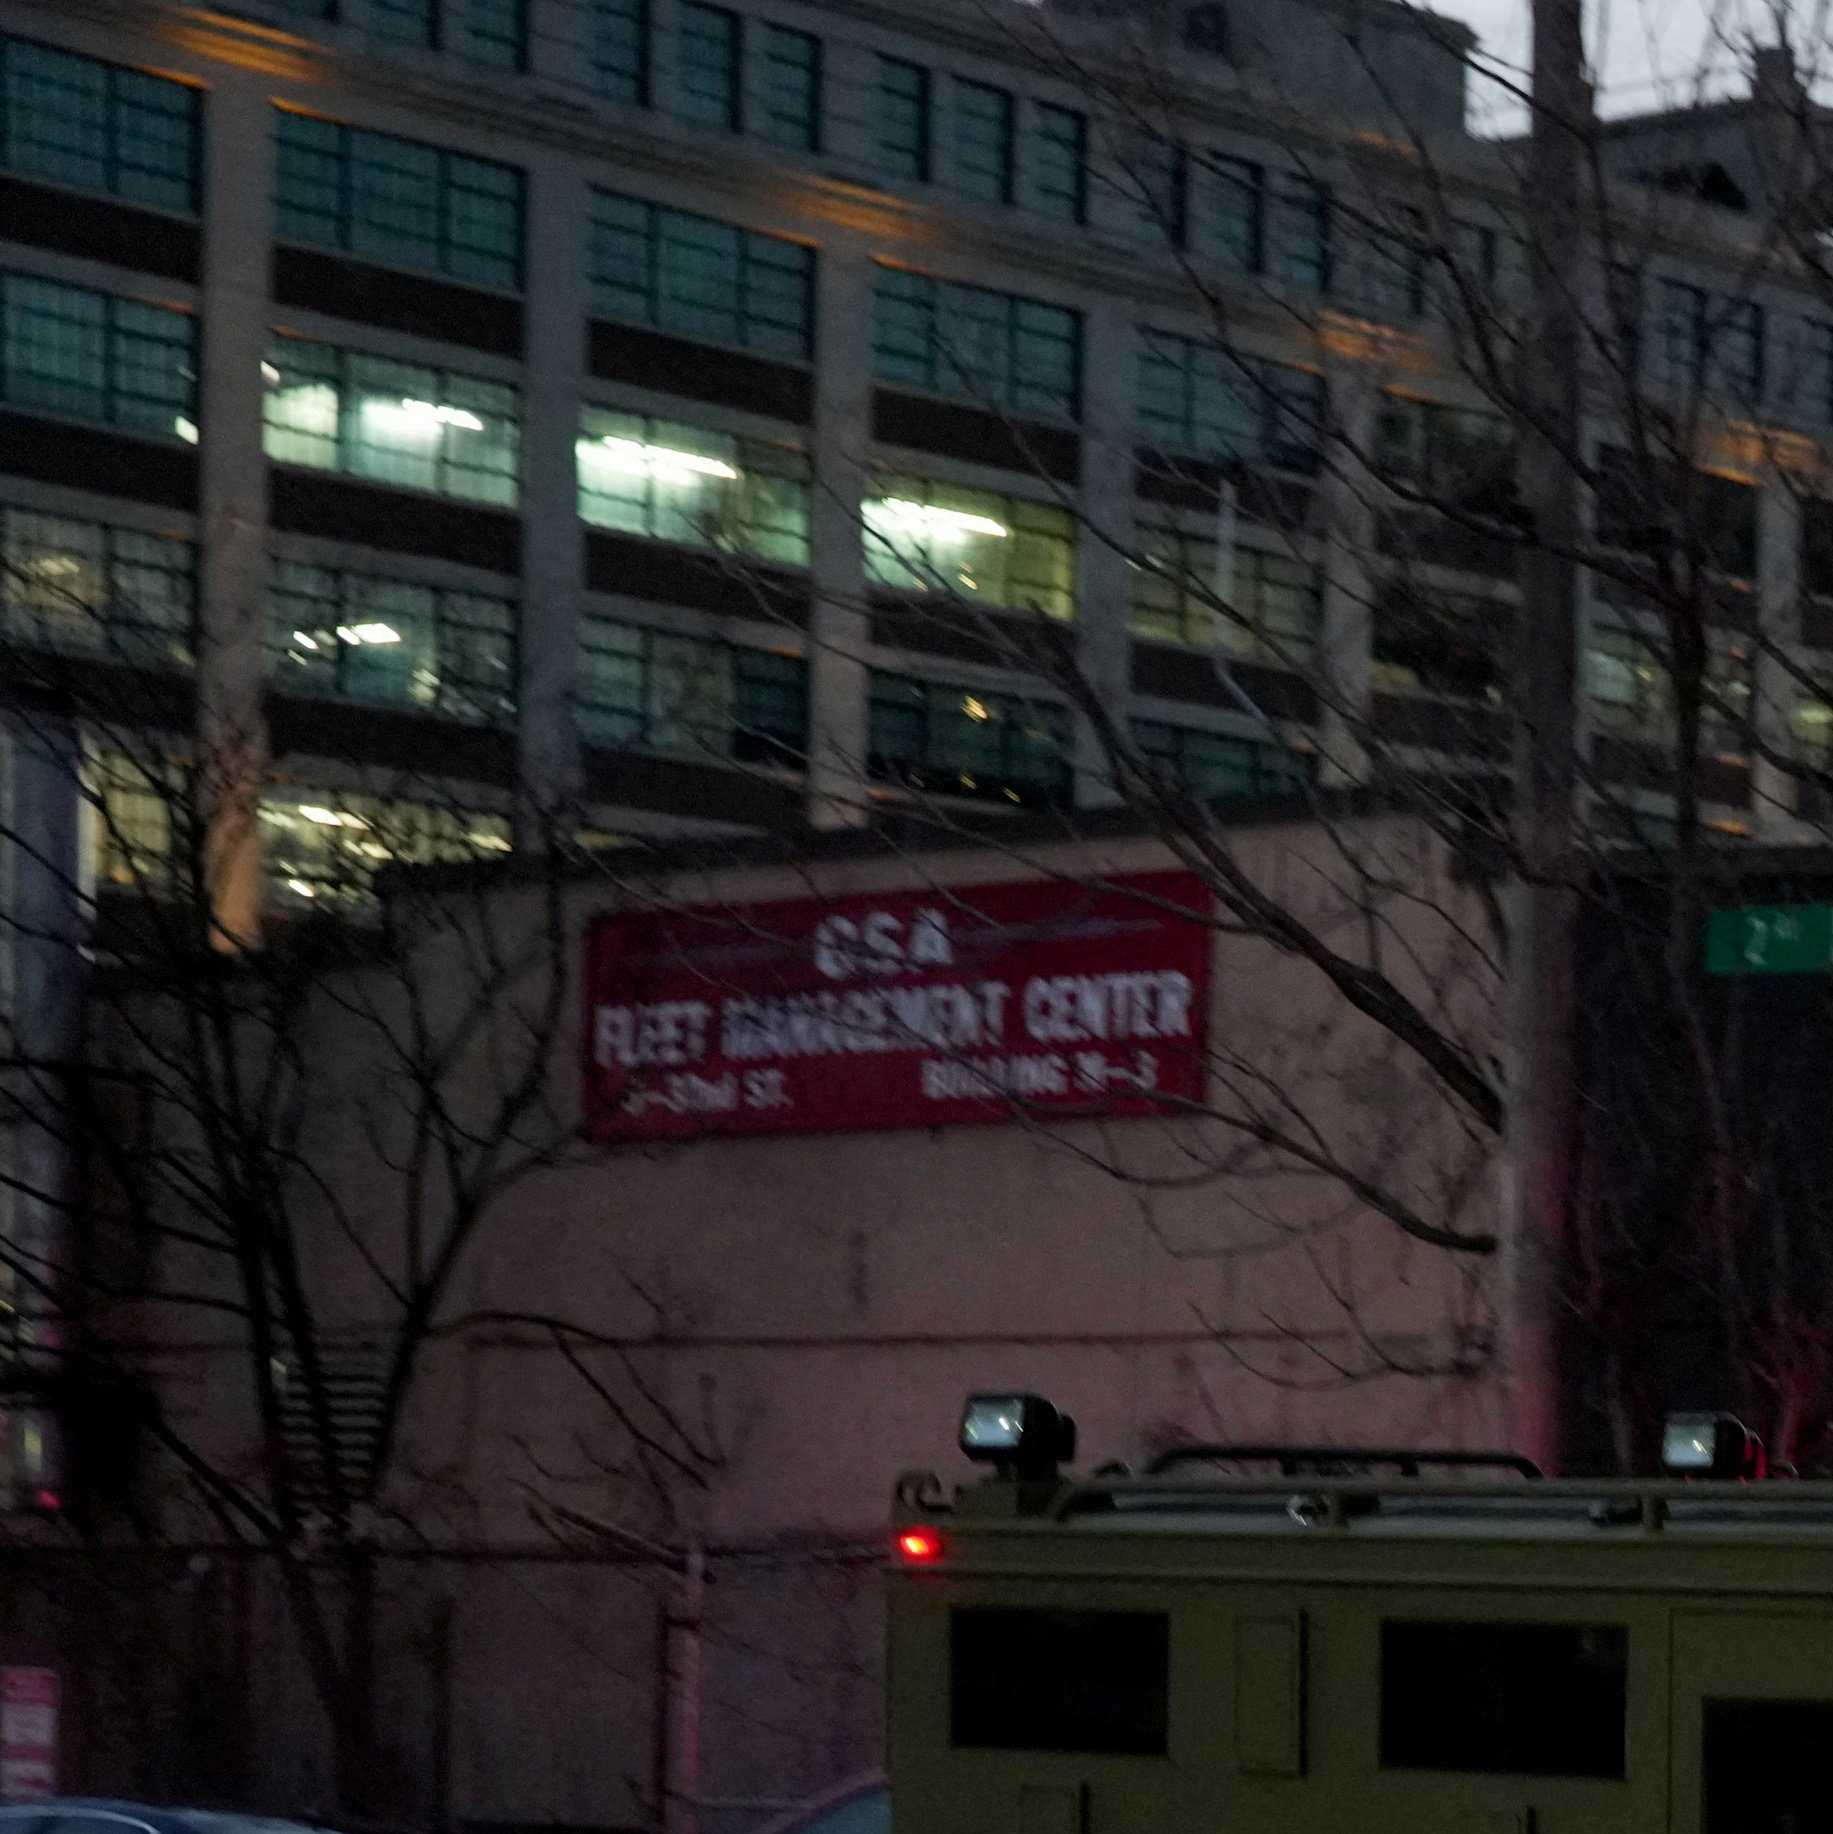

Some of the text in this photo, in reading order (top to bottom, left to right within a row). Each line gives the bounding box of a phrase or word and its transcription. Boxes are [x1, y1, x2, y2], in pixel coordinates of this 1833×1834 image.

[815, 908, 952, 979] GSA
[595, 970, 1192, 1067] FLEET MANAGEMENT CENTER
